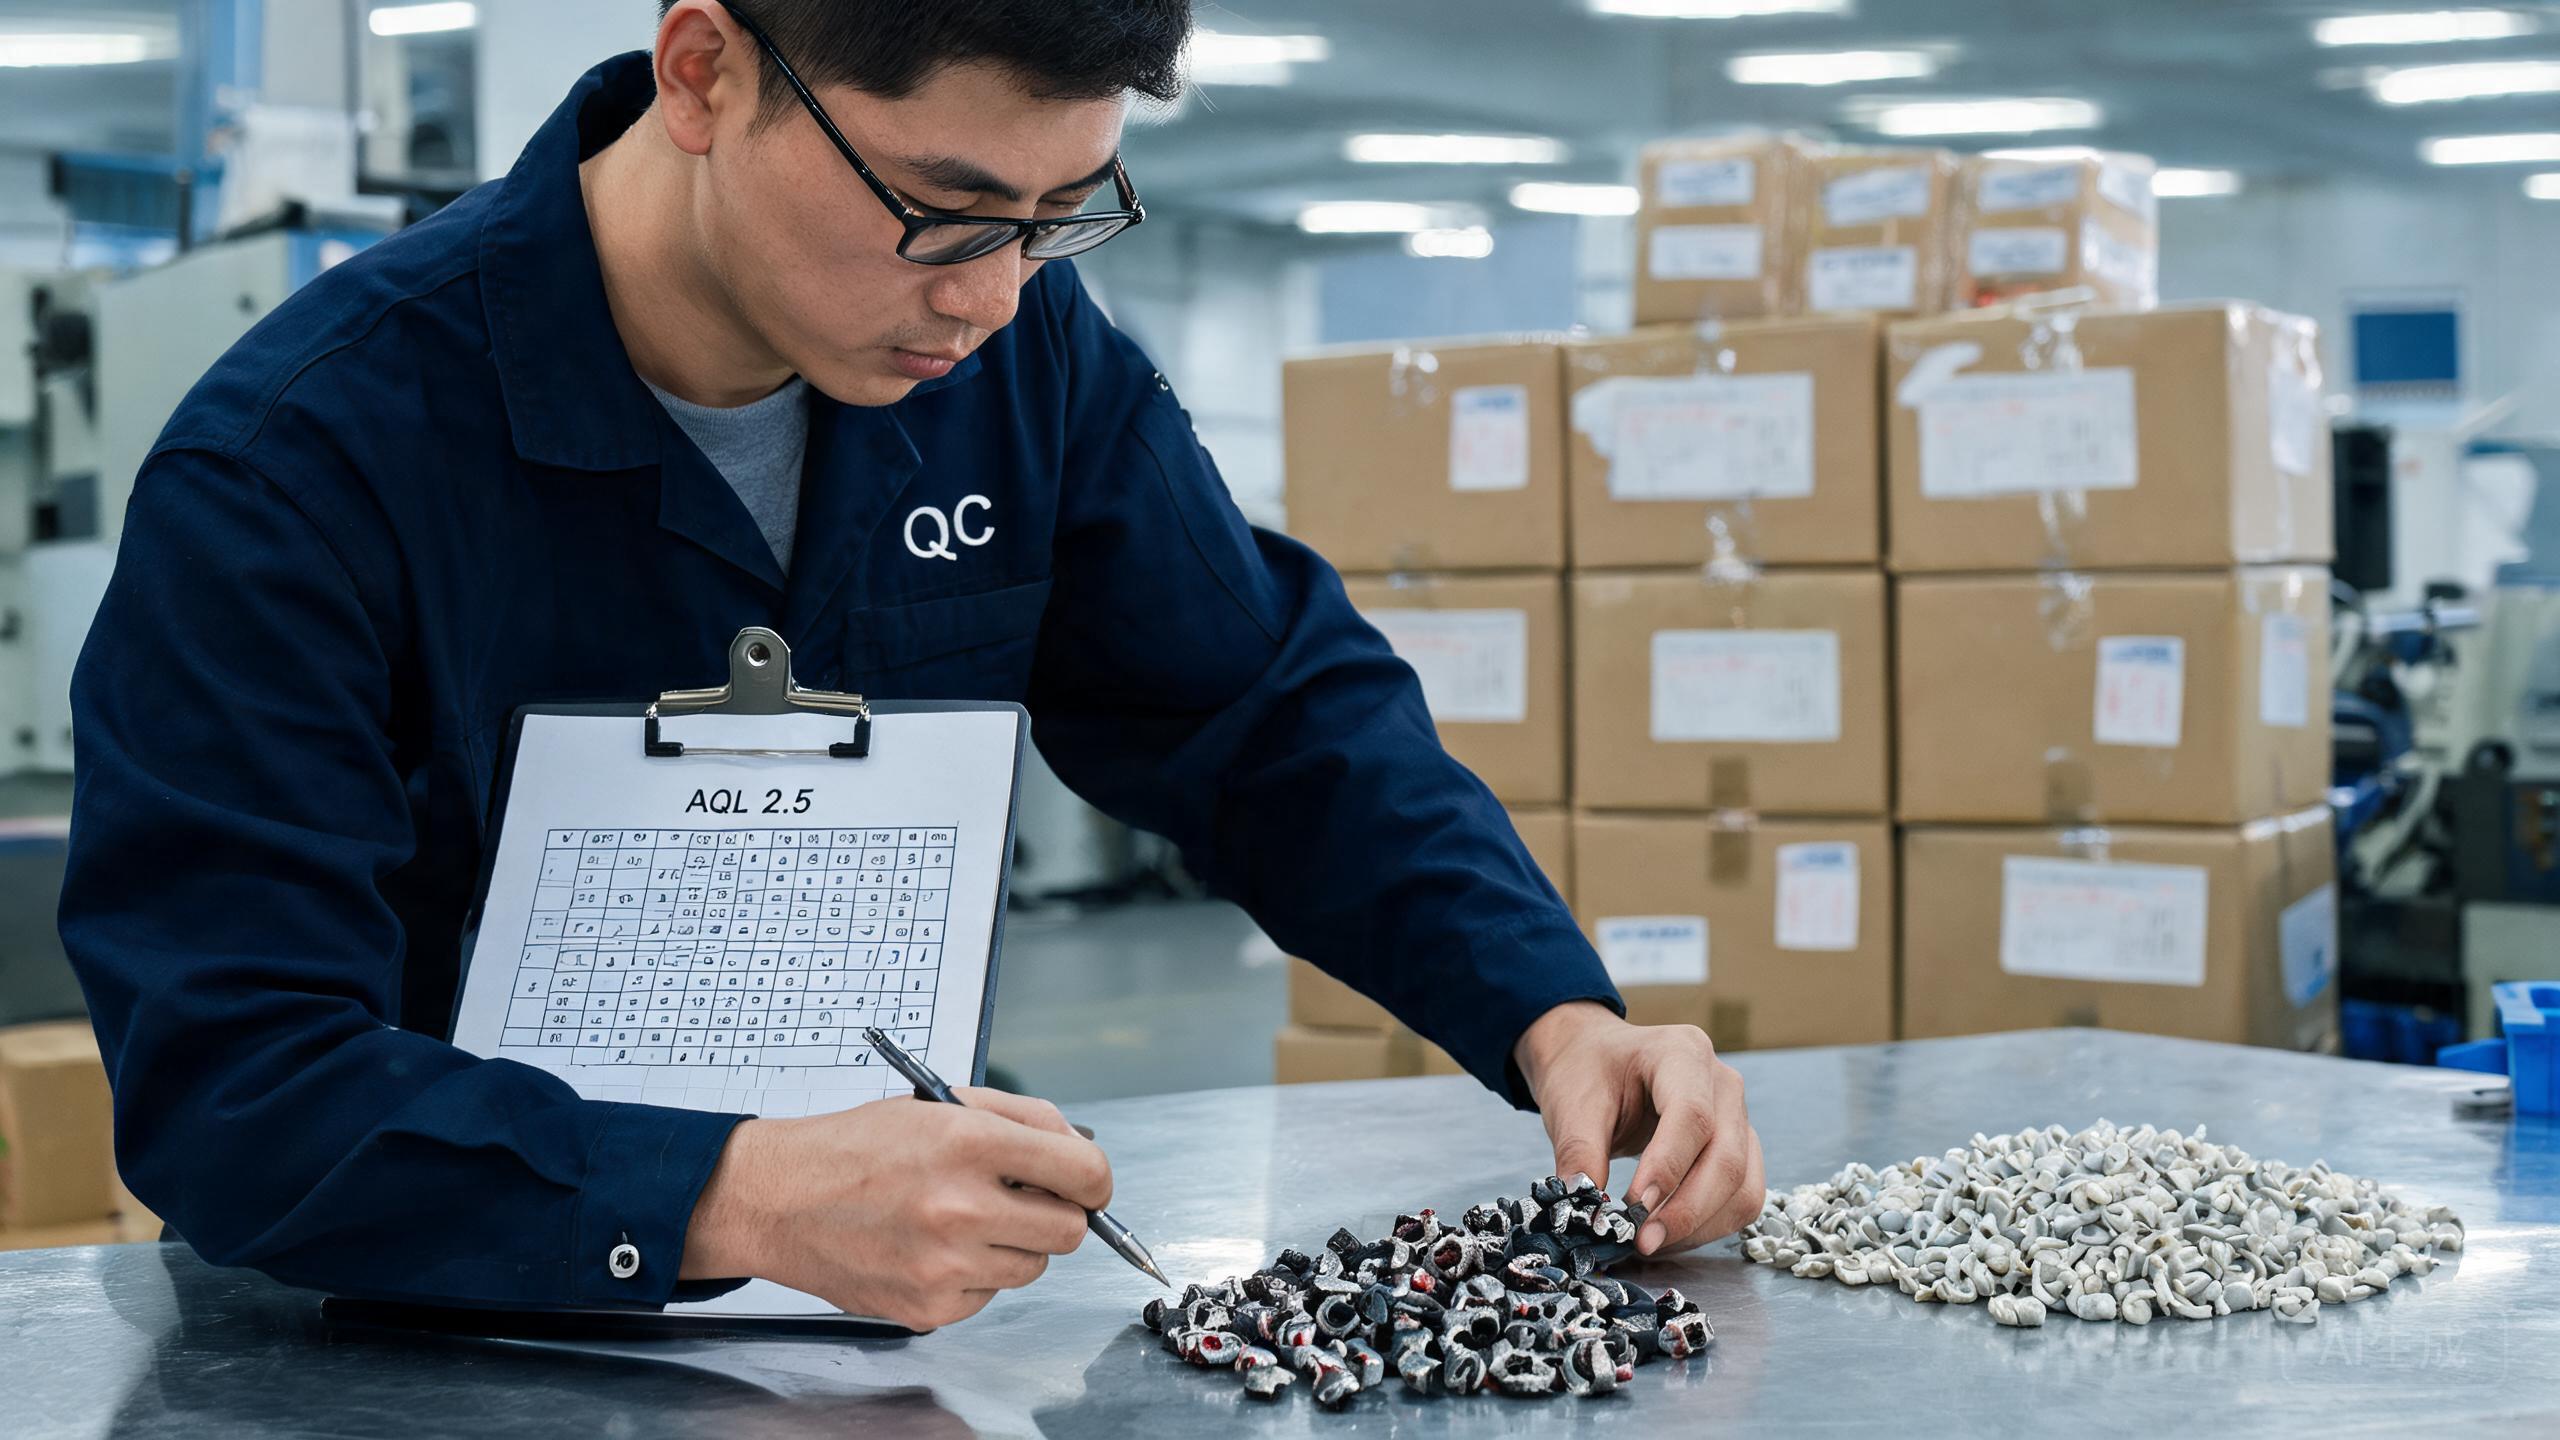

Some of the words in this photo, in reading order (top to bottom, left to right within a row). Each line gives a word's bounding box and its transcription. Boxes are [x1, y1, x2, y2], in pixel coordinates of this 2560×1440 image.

[903, 494, 995, 561] QC
[685, 789, 748, 814] AQL
[761, 788, 814, 814] 2.5
